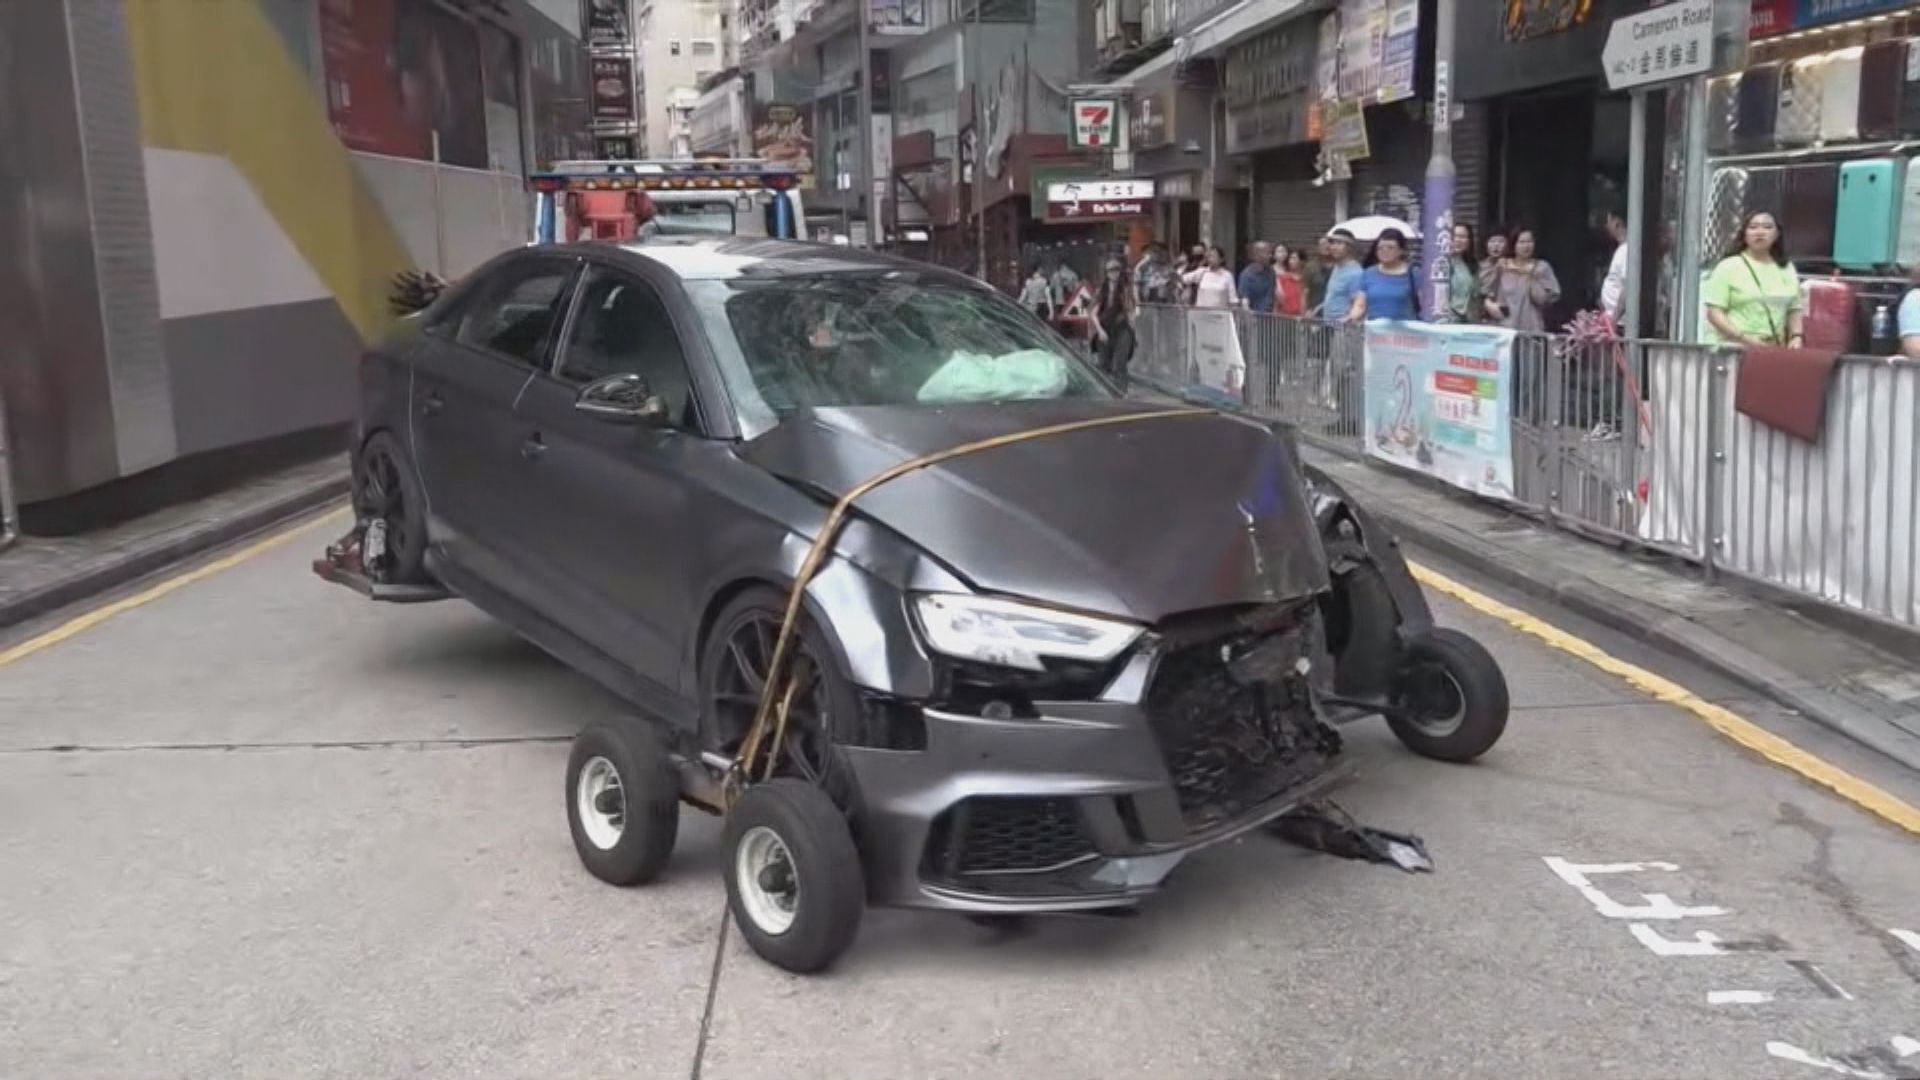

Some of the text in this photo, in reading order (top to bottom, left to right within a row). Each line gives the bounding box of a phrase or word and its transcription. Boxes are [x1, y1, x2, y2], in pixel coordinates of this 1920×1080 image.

[1632, 6, 1712, 41] Cameron Road
[1080, 106, 1109, 124] 7
